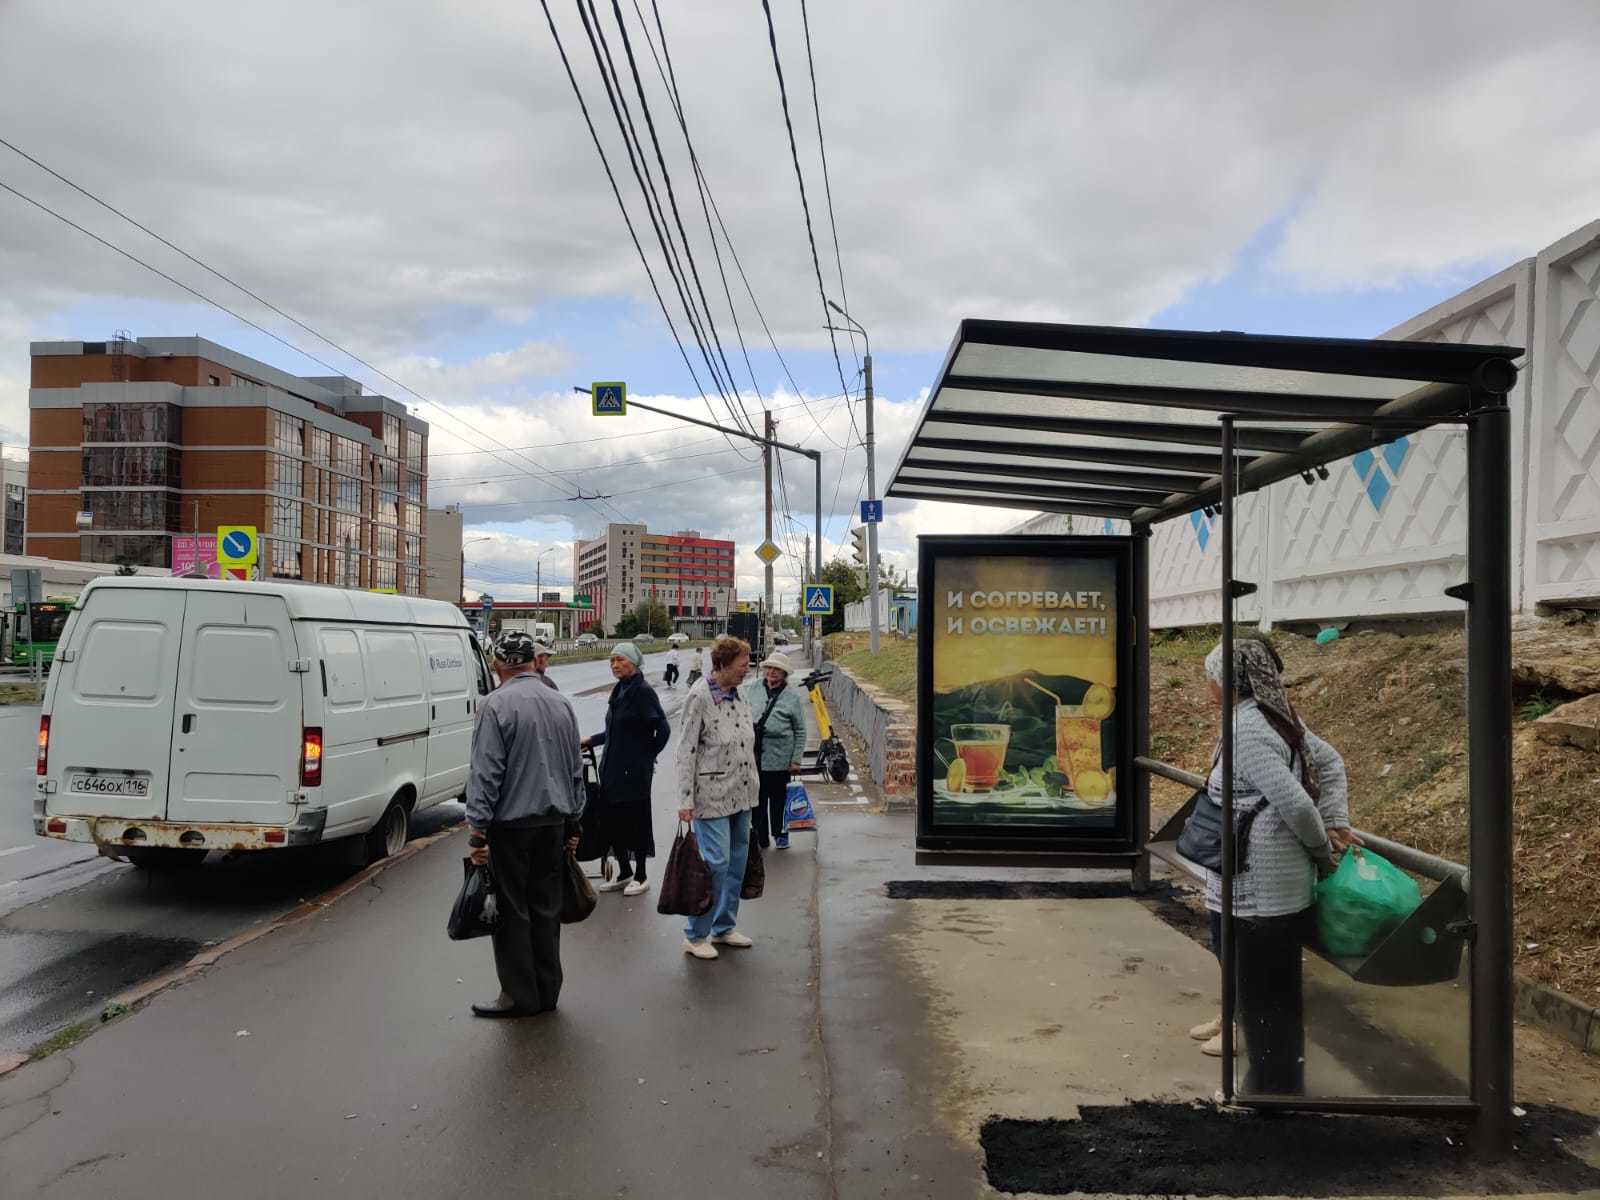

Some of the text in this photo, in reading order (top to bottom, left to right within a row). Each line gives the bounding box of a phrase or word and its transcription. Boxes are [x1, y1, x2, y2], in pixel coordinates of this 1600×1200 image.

[947, 591, 1106, 611] И СОГРЕВАЕТ,
[947, 617, 1106, 635] И ОСВЕЖАЕТ!
